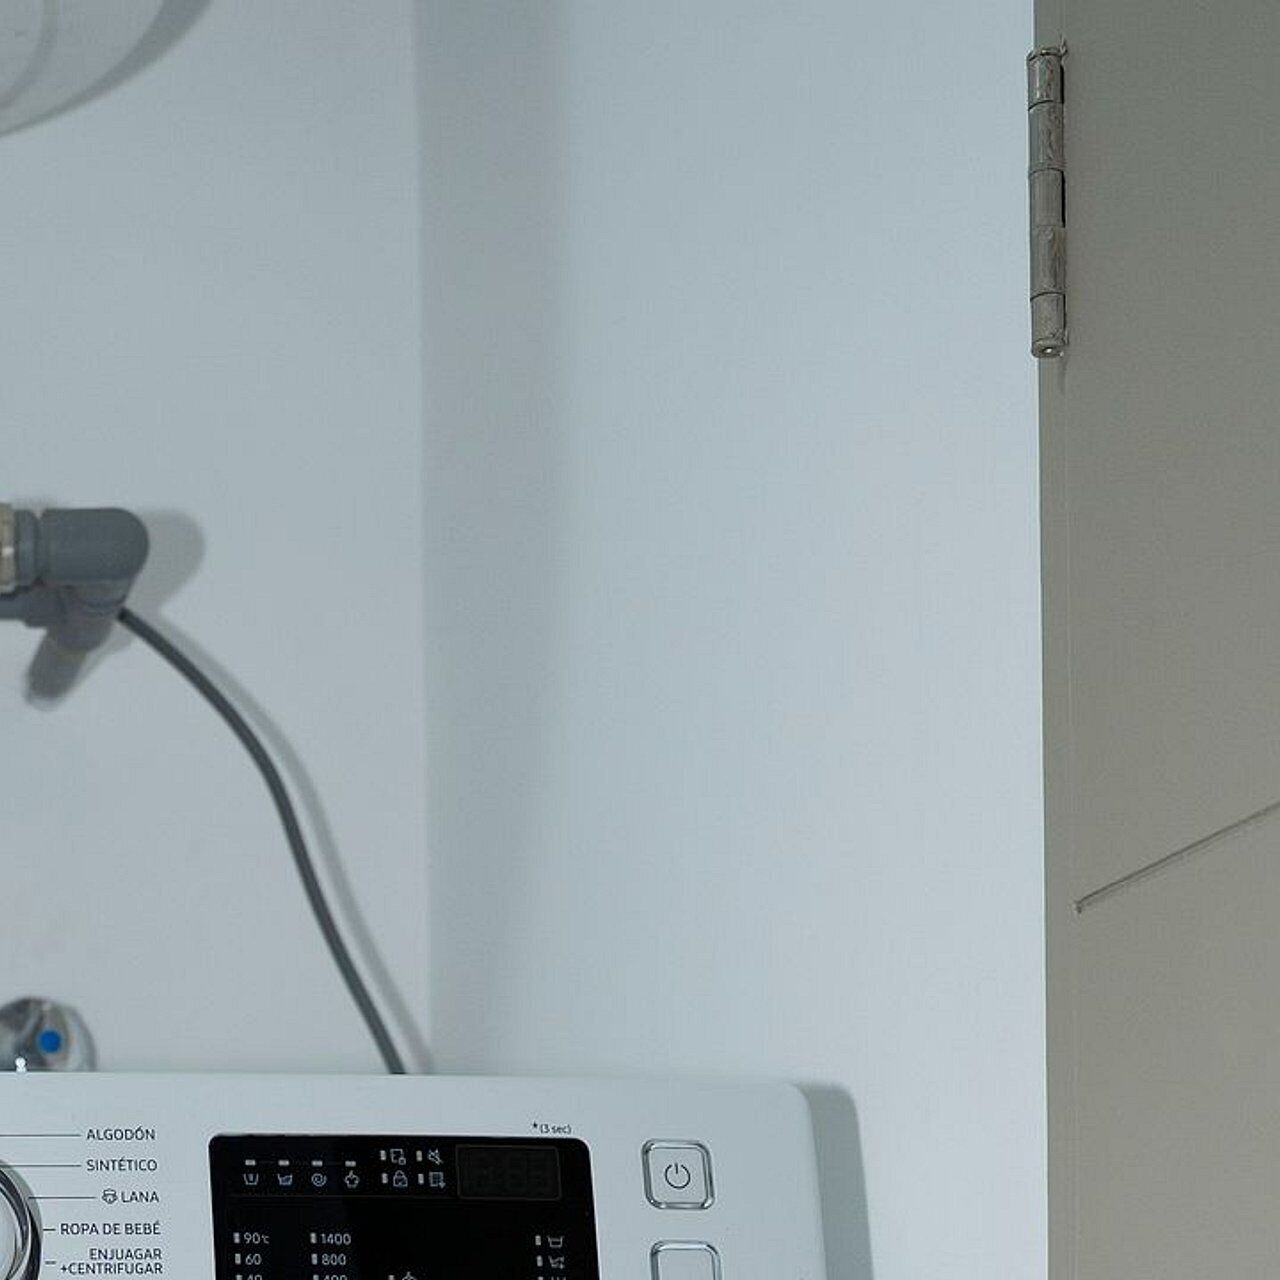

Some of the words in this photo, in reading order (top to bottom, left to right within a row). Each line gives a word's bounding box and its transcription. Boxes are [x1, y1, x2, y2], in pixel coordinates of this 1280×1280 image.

[86, 1125, 156, 1141] ALGODÓN
[552, 1123, 572, 1134] sec)
[86, 1156, 158, 1171] SINTÉTICO
[121, 1191, 160, 1203] LANA
[60, 1223, 99, 1235] ROPA
[103, 1223, 121, 1235] DE
[124, 1219, 161, 1235] BEBÉ
[320, 1233, 351, 1245] 1400
[89, 1248, 162, 1260] ENJUAGAR
[245, 1253, 262, 1265] 60
[321, 1253, 346, 1265] 800
[60, 1262, 163, 1275] +CENTRIFUGAR
